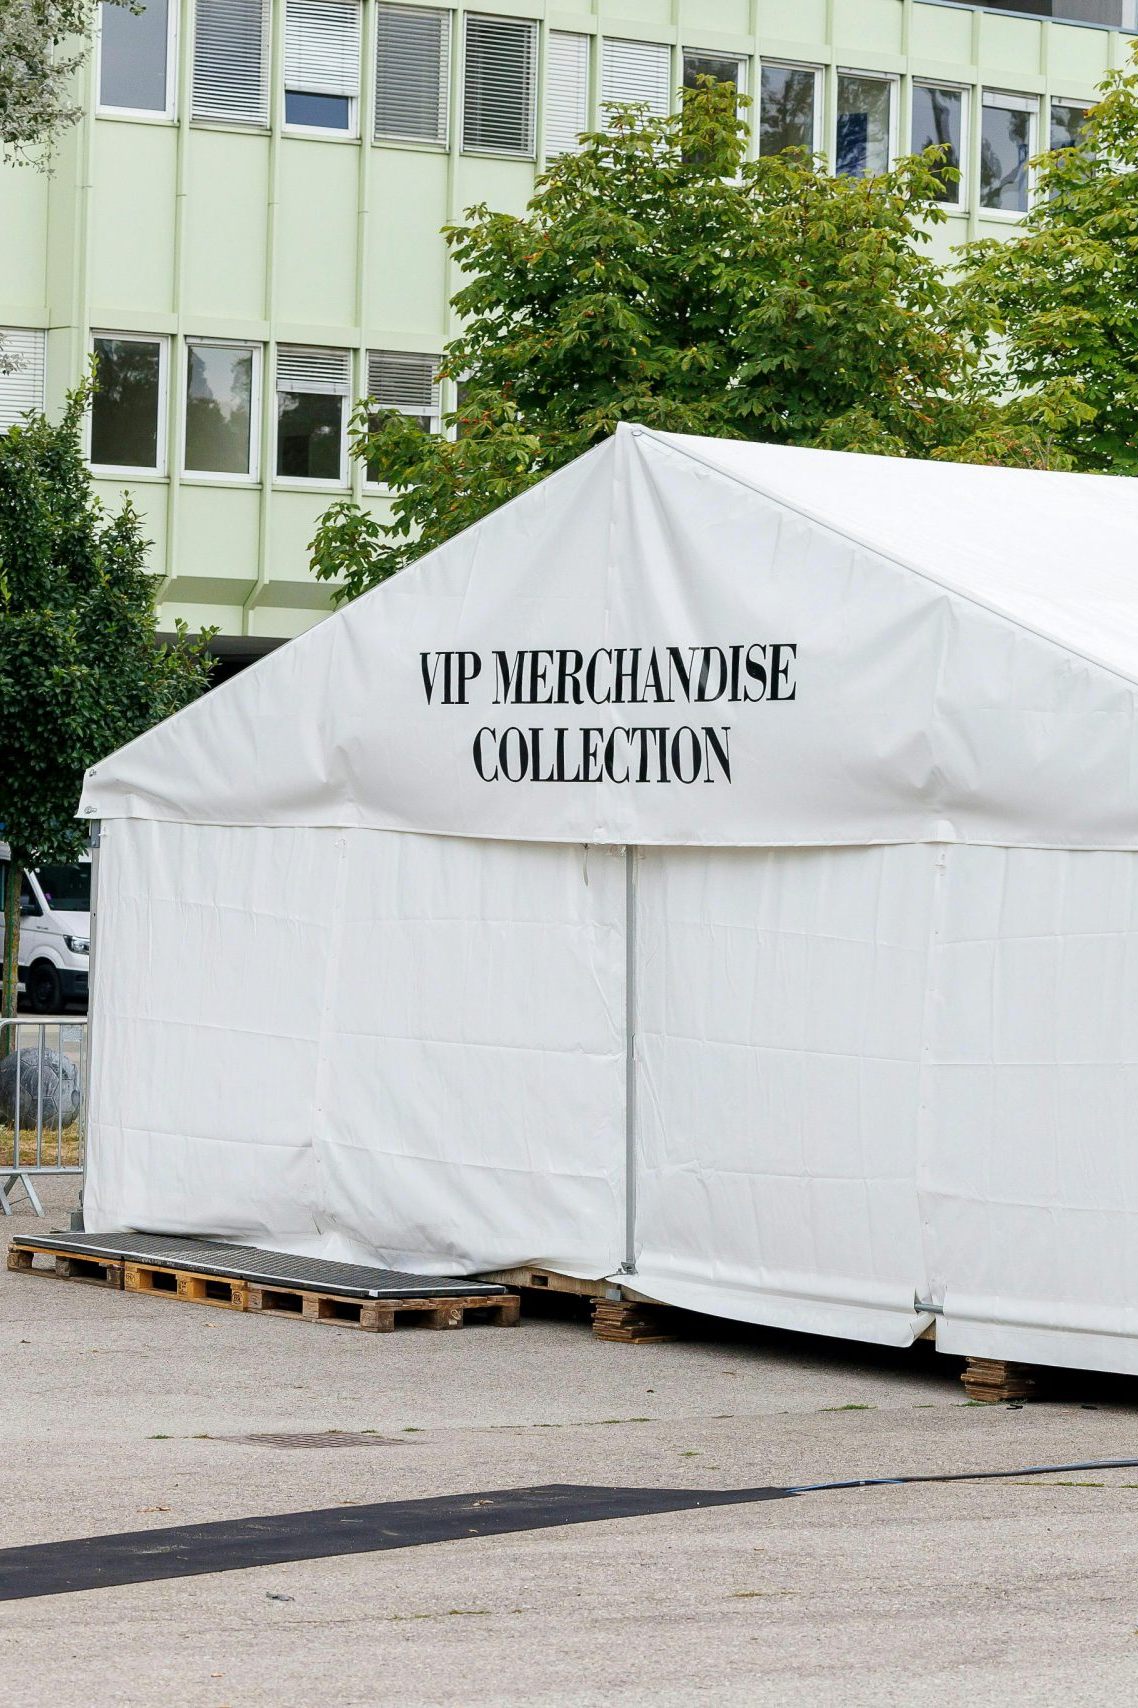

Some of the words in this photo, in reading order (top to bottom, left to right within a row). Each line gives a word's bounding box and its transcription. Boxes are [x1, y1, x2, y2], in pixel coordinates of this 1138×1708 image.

[420, 651, 482, 705] VIP
[492, 643, 798, 705] MERCHANDISE
[472, 726, 732, 784] COLLECTION
